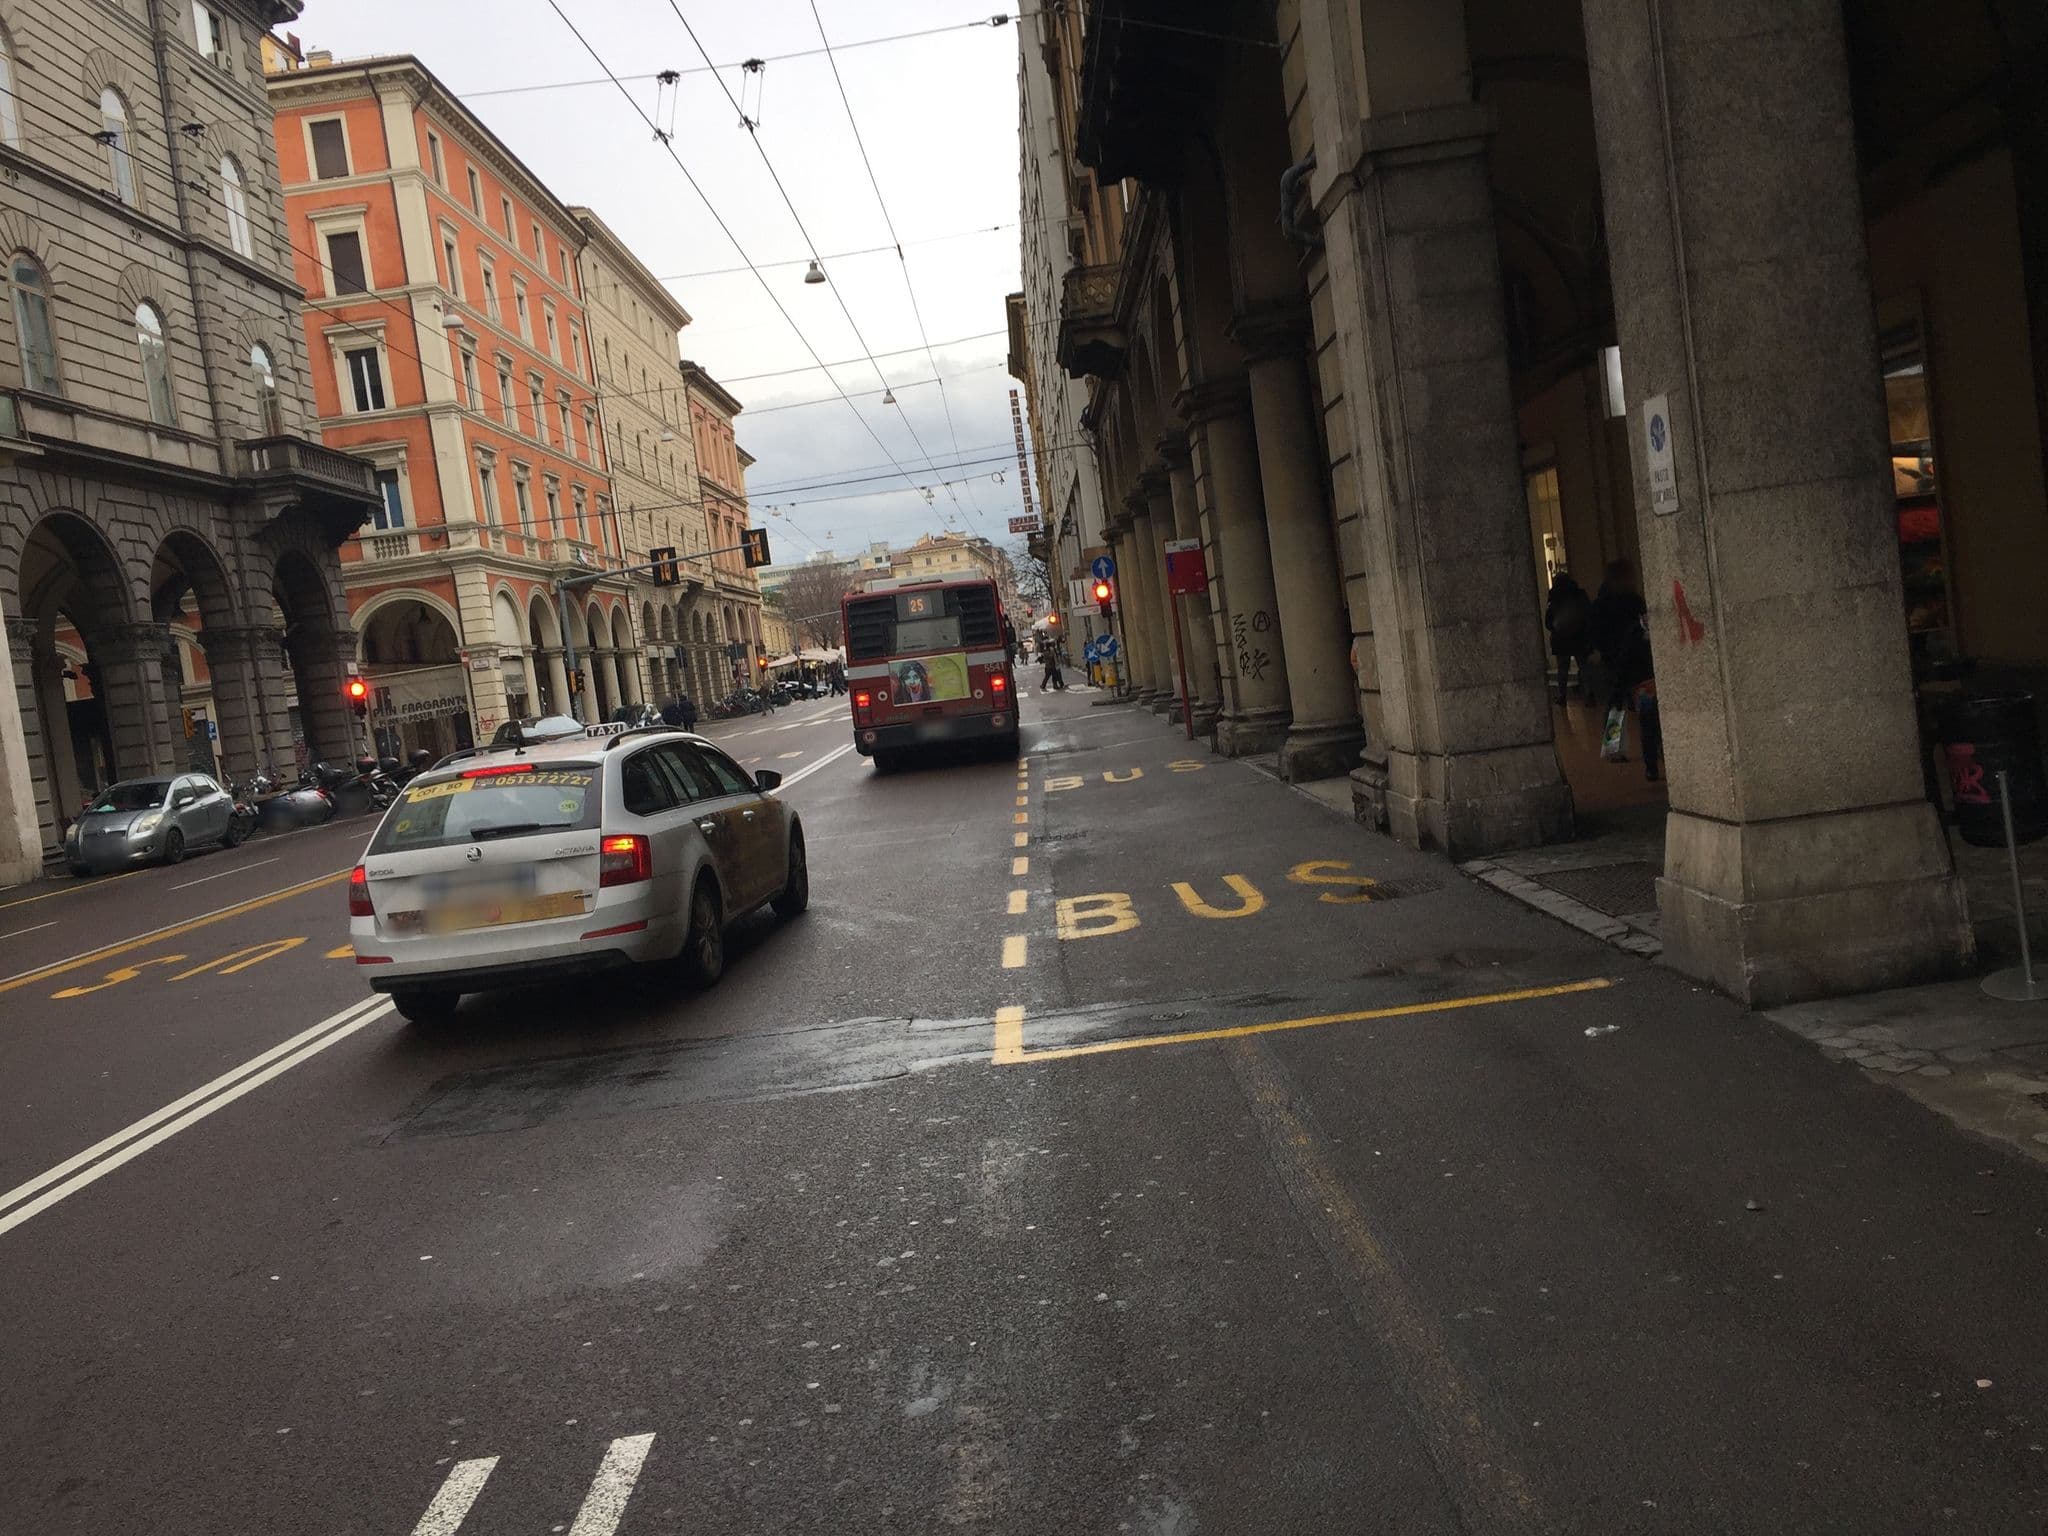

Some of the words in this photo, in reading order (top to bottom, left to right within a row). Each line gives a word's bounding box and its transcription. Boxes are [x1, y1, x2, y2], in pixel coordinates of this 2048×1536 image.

[910, 598, 924, 612] 25
[588, 724, 622, 737] TAXI
[495, 773, 593, 787] 051372727
[1044, 759, 1206, 793] BUS
[554, 845, 595, 856] OCTAVIA
[1056, 859, 1377, 941] BUS
